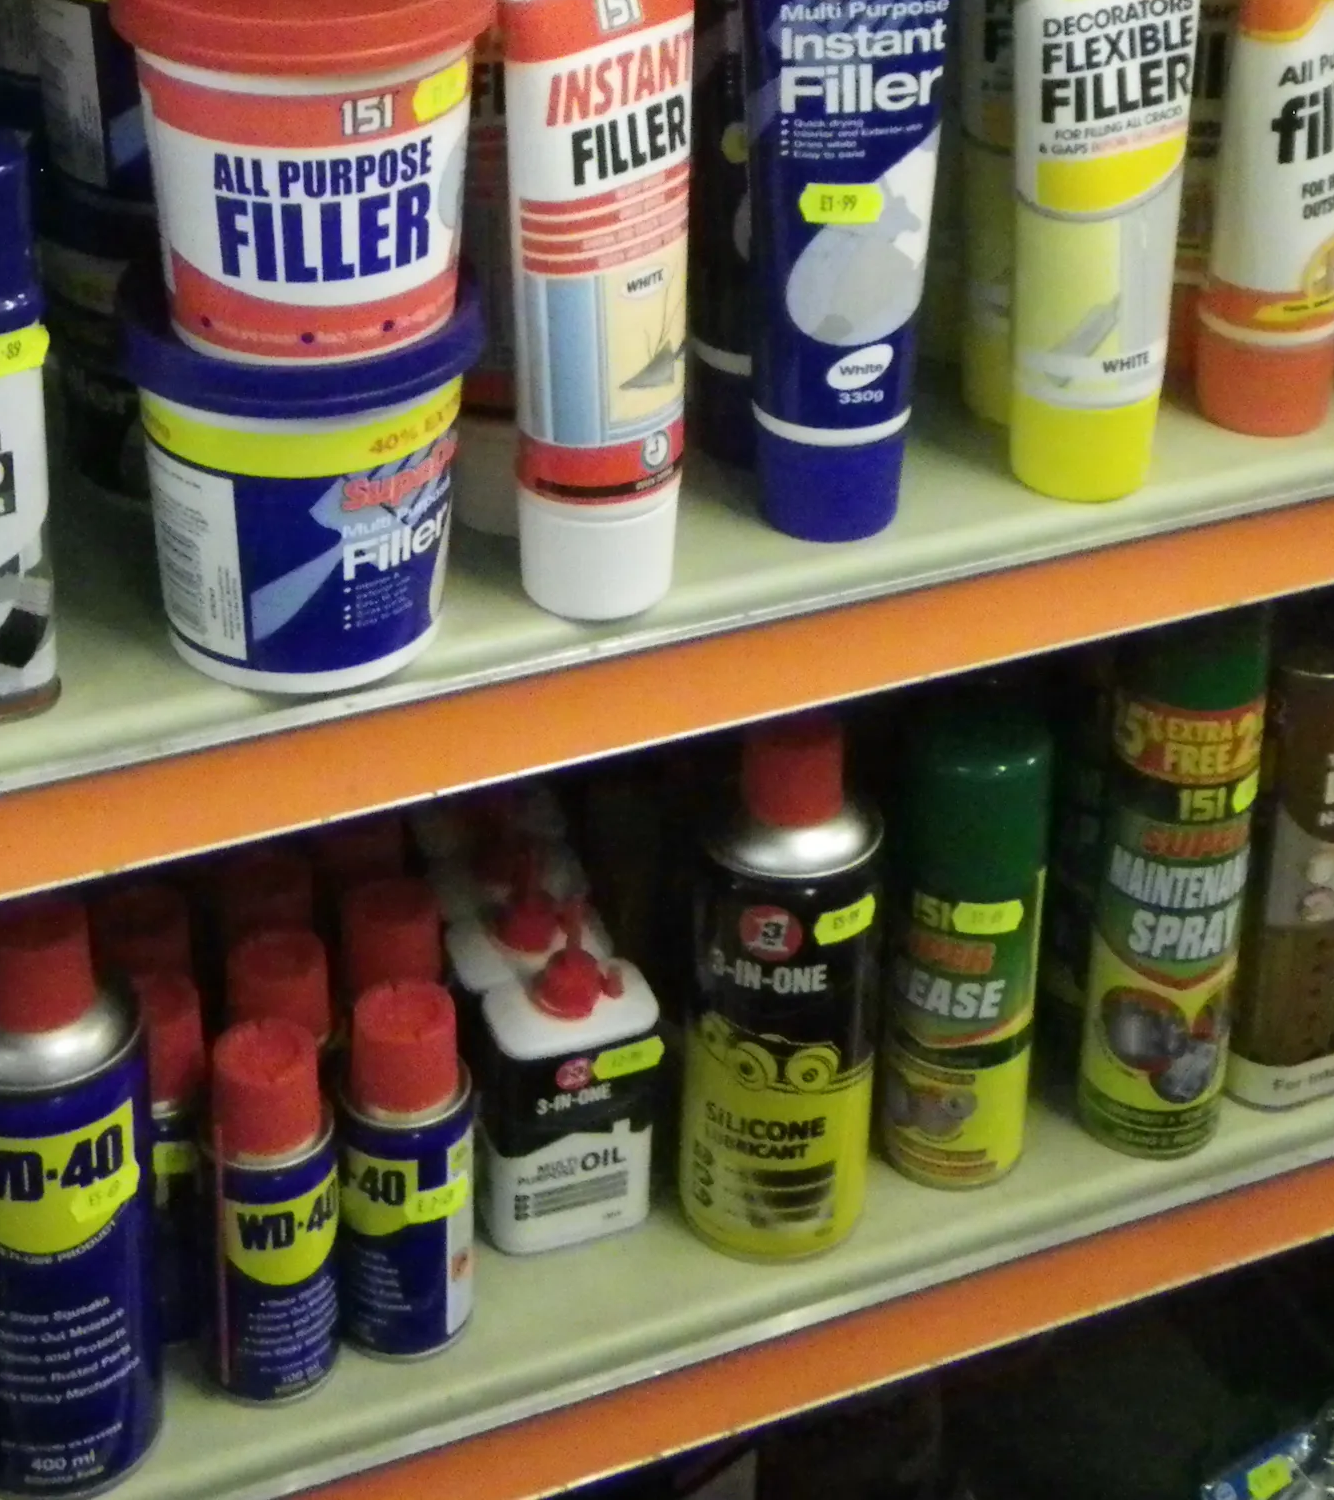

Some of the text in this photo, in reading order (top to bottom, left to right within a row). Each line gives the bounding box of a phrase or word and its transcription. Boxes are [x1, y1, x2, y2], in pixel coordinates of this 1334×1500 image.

[780, 2, 841, 22] Multi
[780, 18, 948, 61] Instant
[1042, 14, 1194, 75] FLEXIBLE
[546, 29, 693, 128] INSTANT
[779, 63, 945, 115] Filler
[1041, 52, 1193, 124] FILLER
[1278, 59, 1315, 88] All
[339, 95, 395, 136] 151
[1054, 104, 1183, 141] FOR FILLING ALL CRACKS
[571, 95, 687, 187] FILLER
[1051, 140, 1088, 155] GAPS
[213, 136, 433, 199] ALL PURPOSE
[214, 182, 433, 285] FILLER
[625, 268, 665, 294] WHITE
[837, 361, 884, 379] White
[1101, 350, 1151, 374] WHITE
[839, 387, 885, 406] 330g
[342, 517, 392, 540] Multi
[342, 503, 448, 582] Filler
[1167, 718, 1233, 743] EXTRA
[1163, 742, 1234, 776] FREE
[1178, 788, 1227, 822] 151
[709, 948, 829, 994] 3-IN-ONE
[536, 1083, 612, 1115] 3-IN-ONE
[1271, 1076, 1303, 1092] For
[705, 1100, 827, 1142] SILICONE
[580, 1146, 626, 1172] OIL
[705, 1122, 809, 1161] LUBRICANT
[237, 1178, 339, 1250] WD-40
